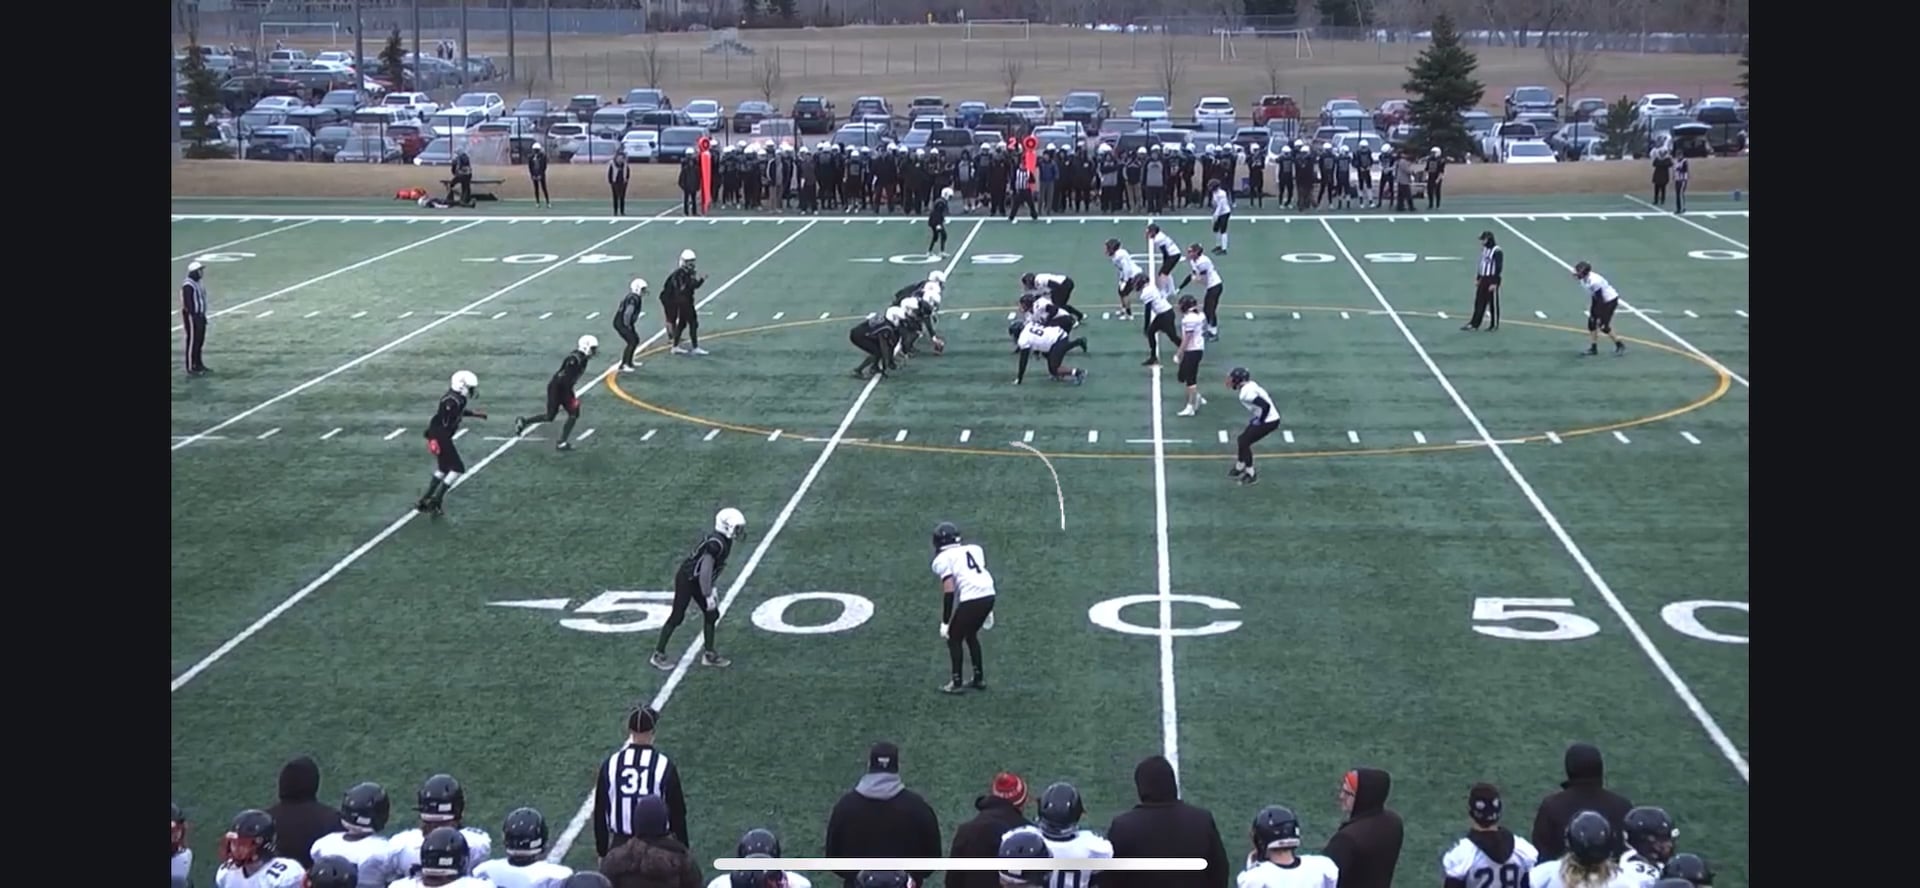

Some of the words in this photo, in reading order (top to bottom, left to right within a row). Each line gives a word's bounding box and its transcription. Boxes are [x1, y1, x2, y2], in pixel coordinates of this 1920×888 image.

[966, 550, 981, 574] 4
[1089, 594, 1243, 636] C
[620, 767, 649, 795] 31
[266, 861, 288, 879] 15
[1636, 863, 1657, 877] 32
